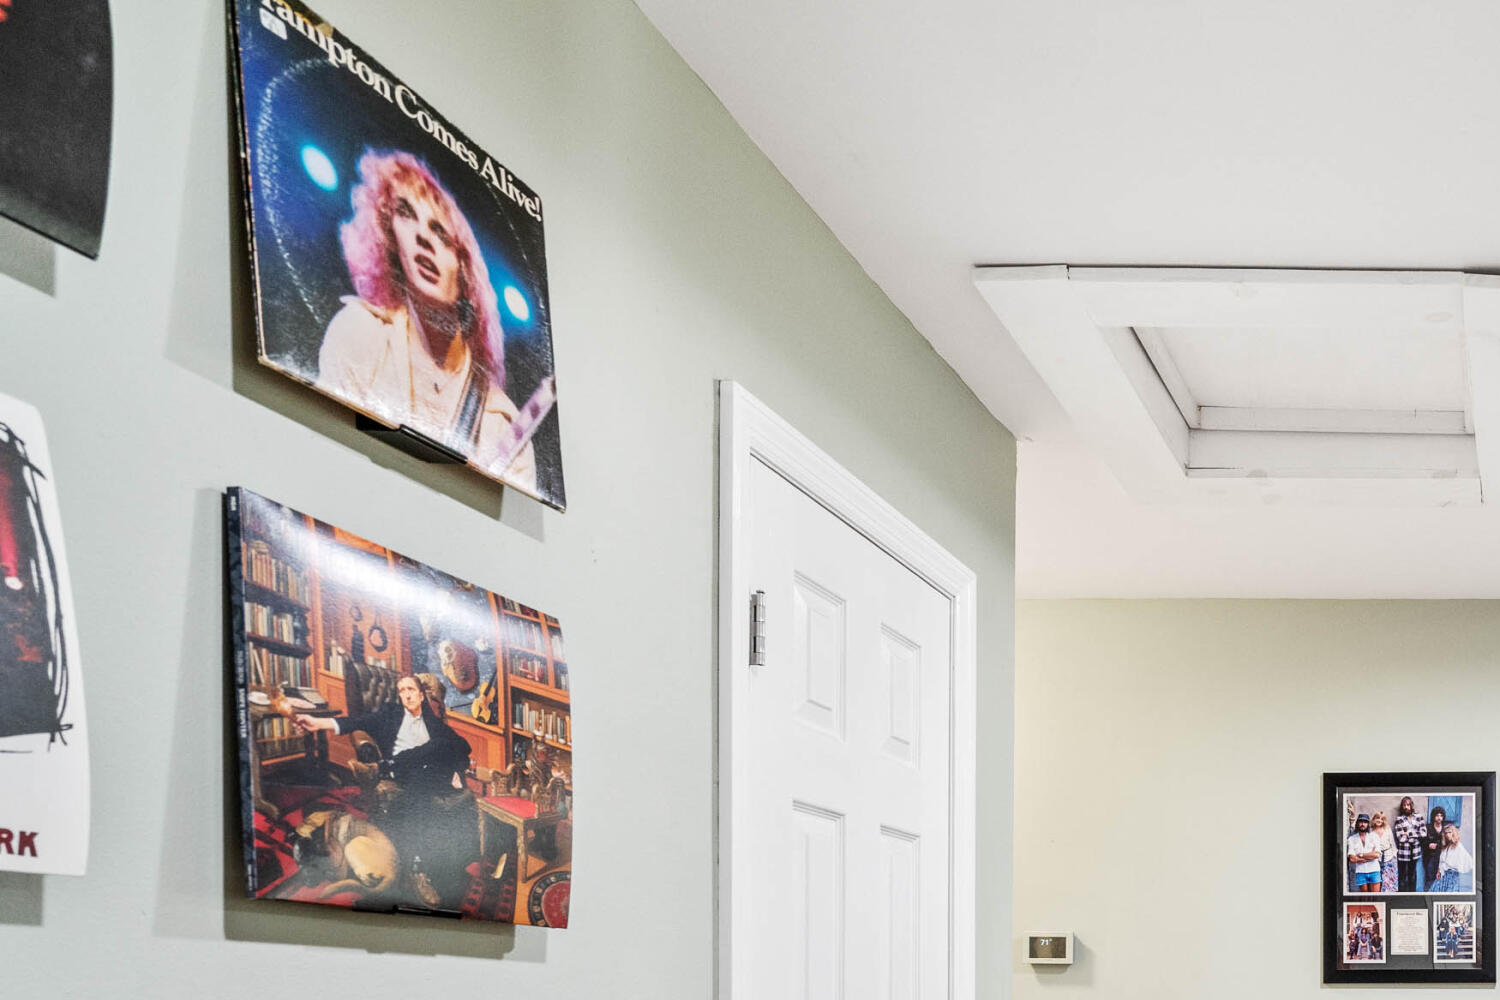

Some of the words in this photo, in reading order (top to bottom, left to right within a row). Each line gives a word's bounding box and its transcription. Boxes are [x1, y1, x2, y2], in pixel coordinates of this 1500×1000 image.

[395, 84, 479, 170] Comes
[481, 157, 542, 222] Alive!
[0, 827, 39, 857] RK
